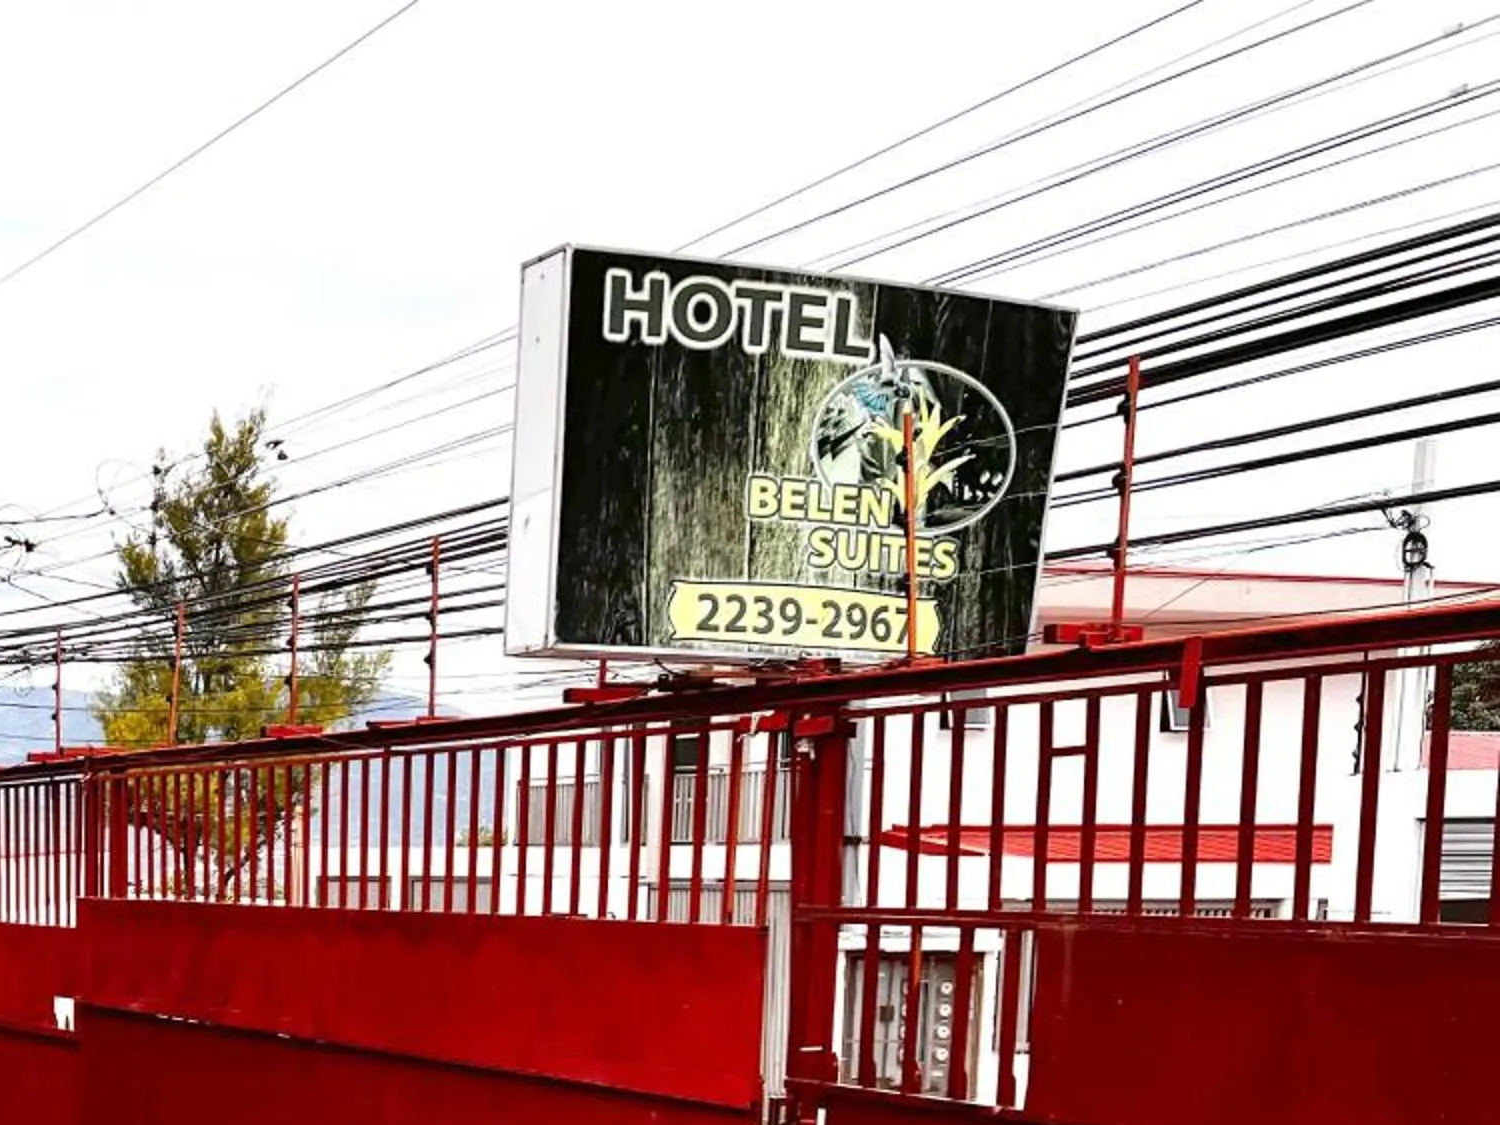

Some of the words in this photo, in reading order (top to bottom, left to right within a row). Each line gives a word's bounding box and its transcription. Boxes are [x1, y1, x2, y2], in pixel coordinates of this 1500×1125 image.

[602, 267, 875, 361] HOTEL
[748, 475, 893, 528] BELEN
[808, 528, 960, 580] SUITES
[695, 592, 912, 647] 2239-2967
